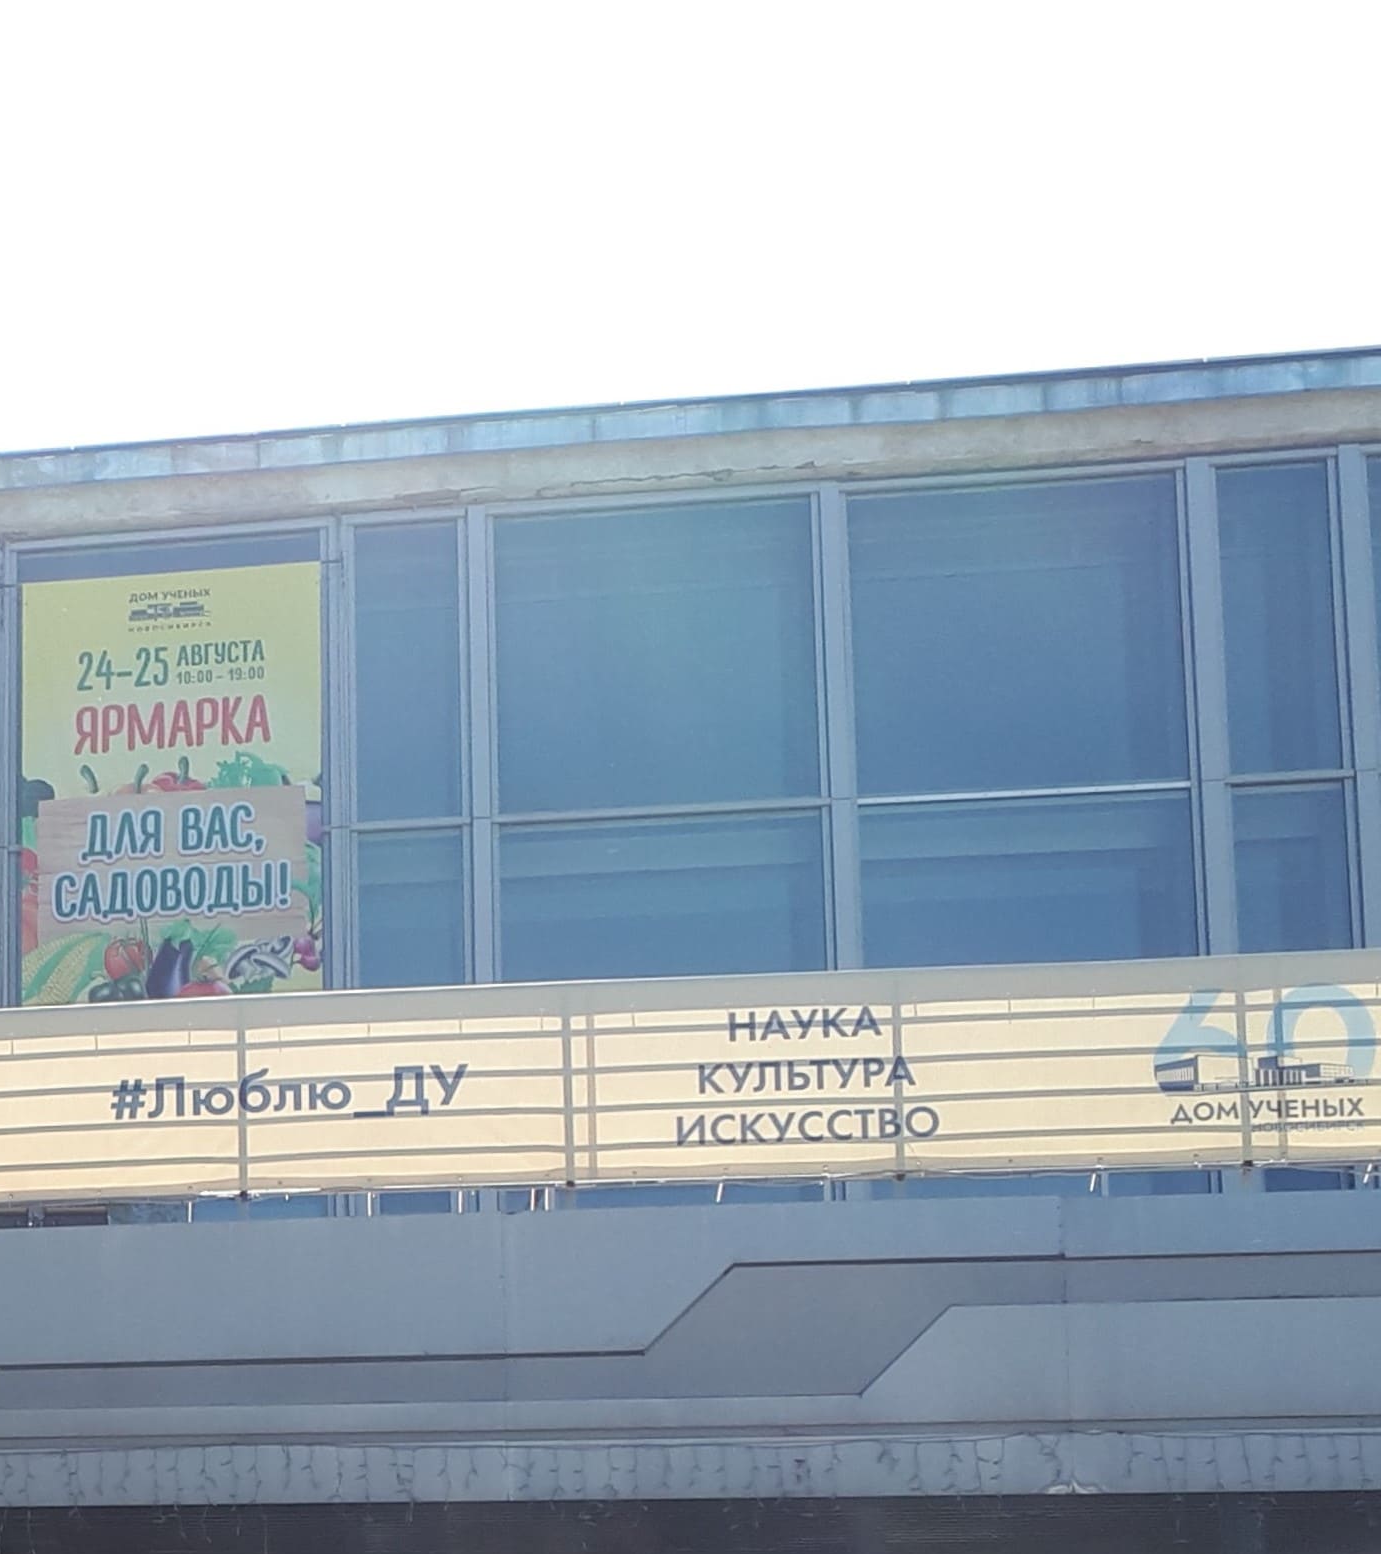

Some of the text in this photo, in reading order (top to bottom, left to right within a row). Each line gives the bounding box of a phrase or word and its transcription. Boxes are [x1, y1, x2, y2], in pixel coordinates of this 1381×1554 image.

[129, 589, 211, 603] ДОМ УЧЕНЫХ
[176, 639, 265, 666] АВГУСТА
[177, 669, 213, 685] 10:00
[228, 666, 265, 681] 19:00
[73, 694, 271, 756] ЯРМАРКА
[81, 803, 265, 860] ДЛЯ ВАС,
[54, 861, 288, 919] САДОВОДЫ!
[728, 1005, 882, 1043] НАУКА
[110, 1063, 470, 1120] #Люблю_ДУ
[697, 1055, 917, 1095] КУЛЬТУРА
[675, 1105, 941, 1147] ИСКУССТВО
[1170, 1097, 1365, 1124] ДОМ УЧЕНЫХ
